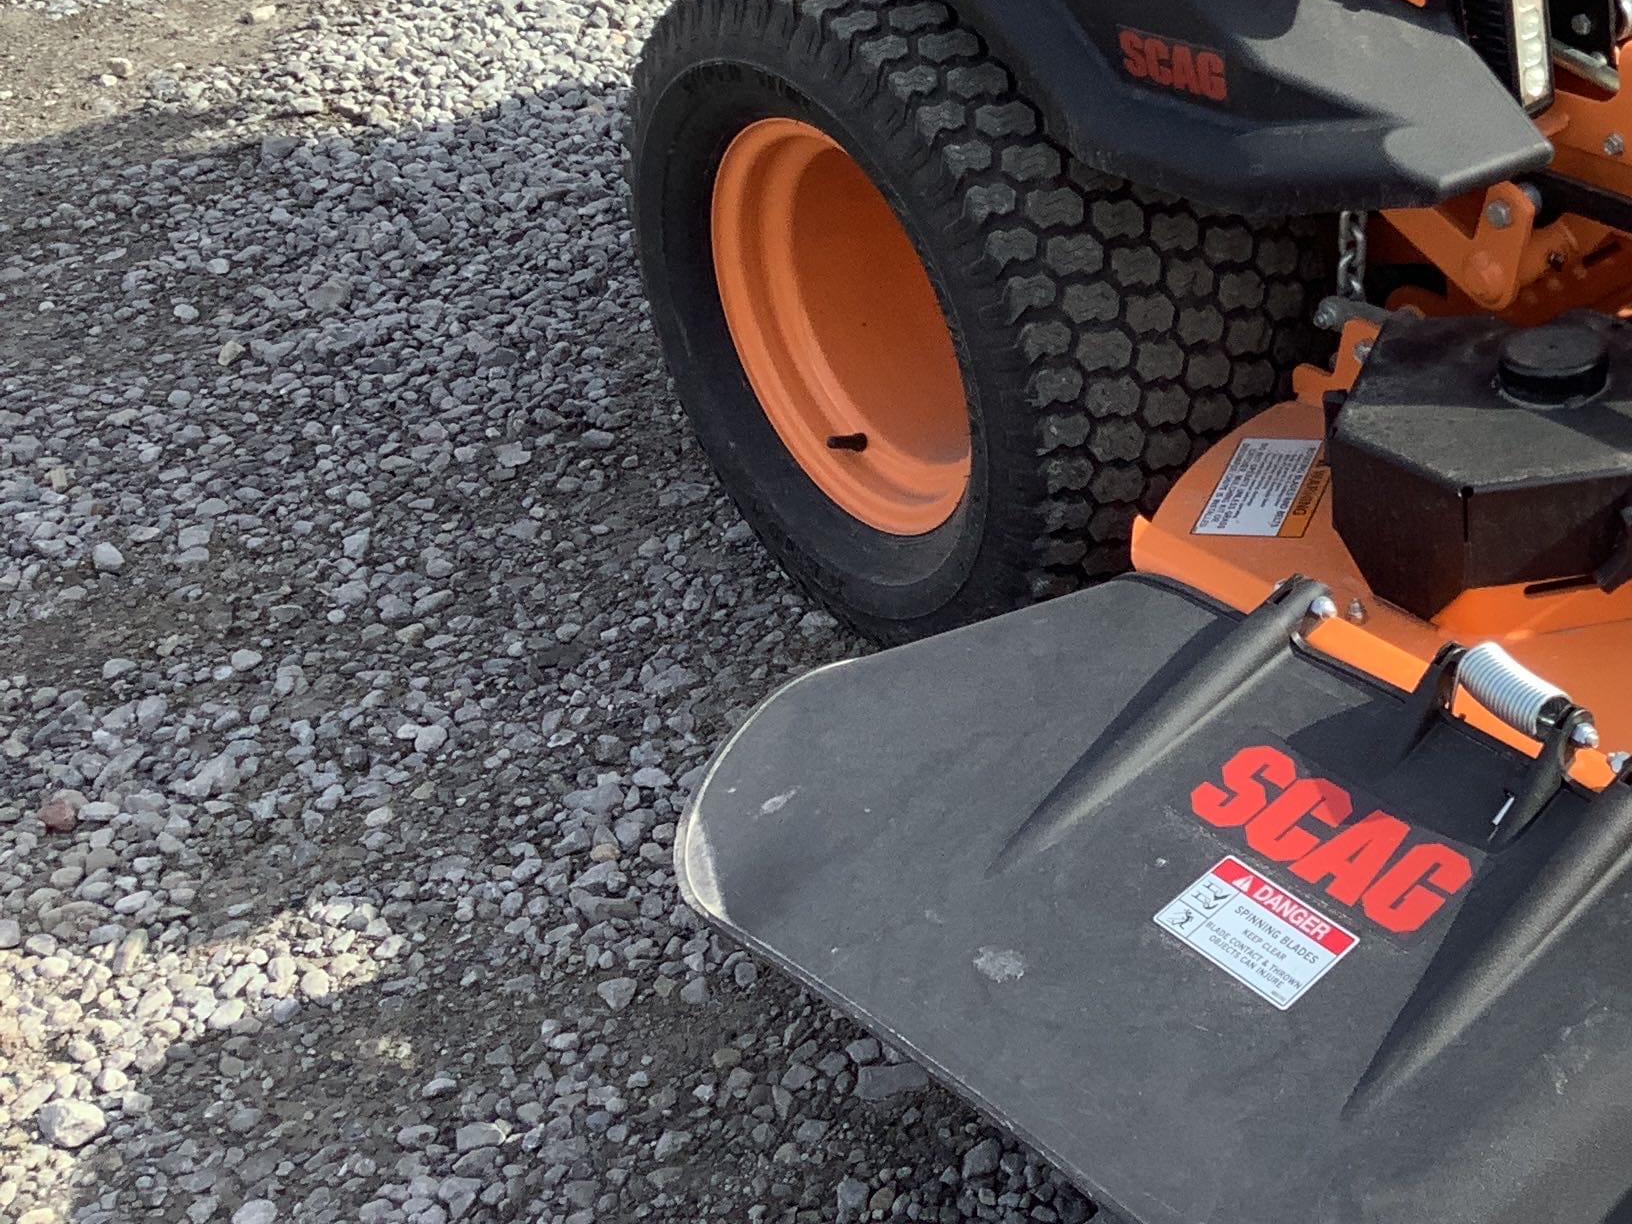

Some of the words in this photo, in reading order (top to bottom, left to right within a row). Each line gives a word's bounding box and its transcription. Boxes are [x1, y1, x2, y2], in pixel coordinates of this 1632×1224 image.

[1119, 30, 1227, 101] SCAG
[1190, 745, 1472, 932] SCAG
[1233, 905, 1282, 939] SPINNING
[1279, 935, 1319, 964] BLADES
[1251, 884, 1333, 940] DANGER
[1205, 921, 1230, 939] BLADE
[1228, 936, 1262, 961] CONTACT
[1268, 964, 1302, 989] THROWN
[1208, 934, 1240, 958] OBJECTS
[1239, 956, 1256, 969] CAN
[1255, 967, 1283, 988] INJURE
[1241, 928, 1263, 944] KEEP
[1261, 942, 1287, 961] CLEAR
